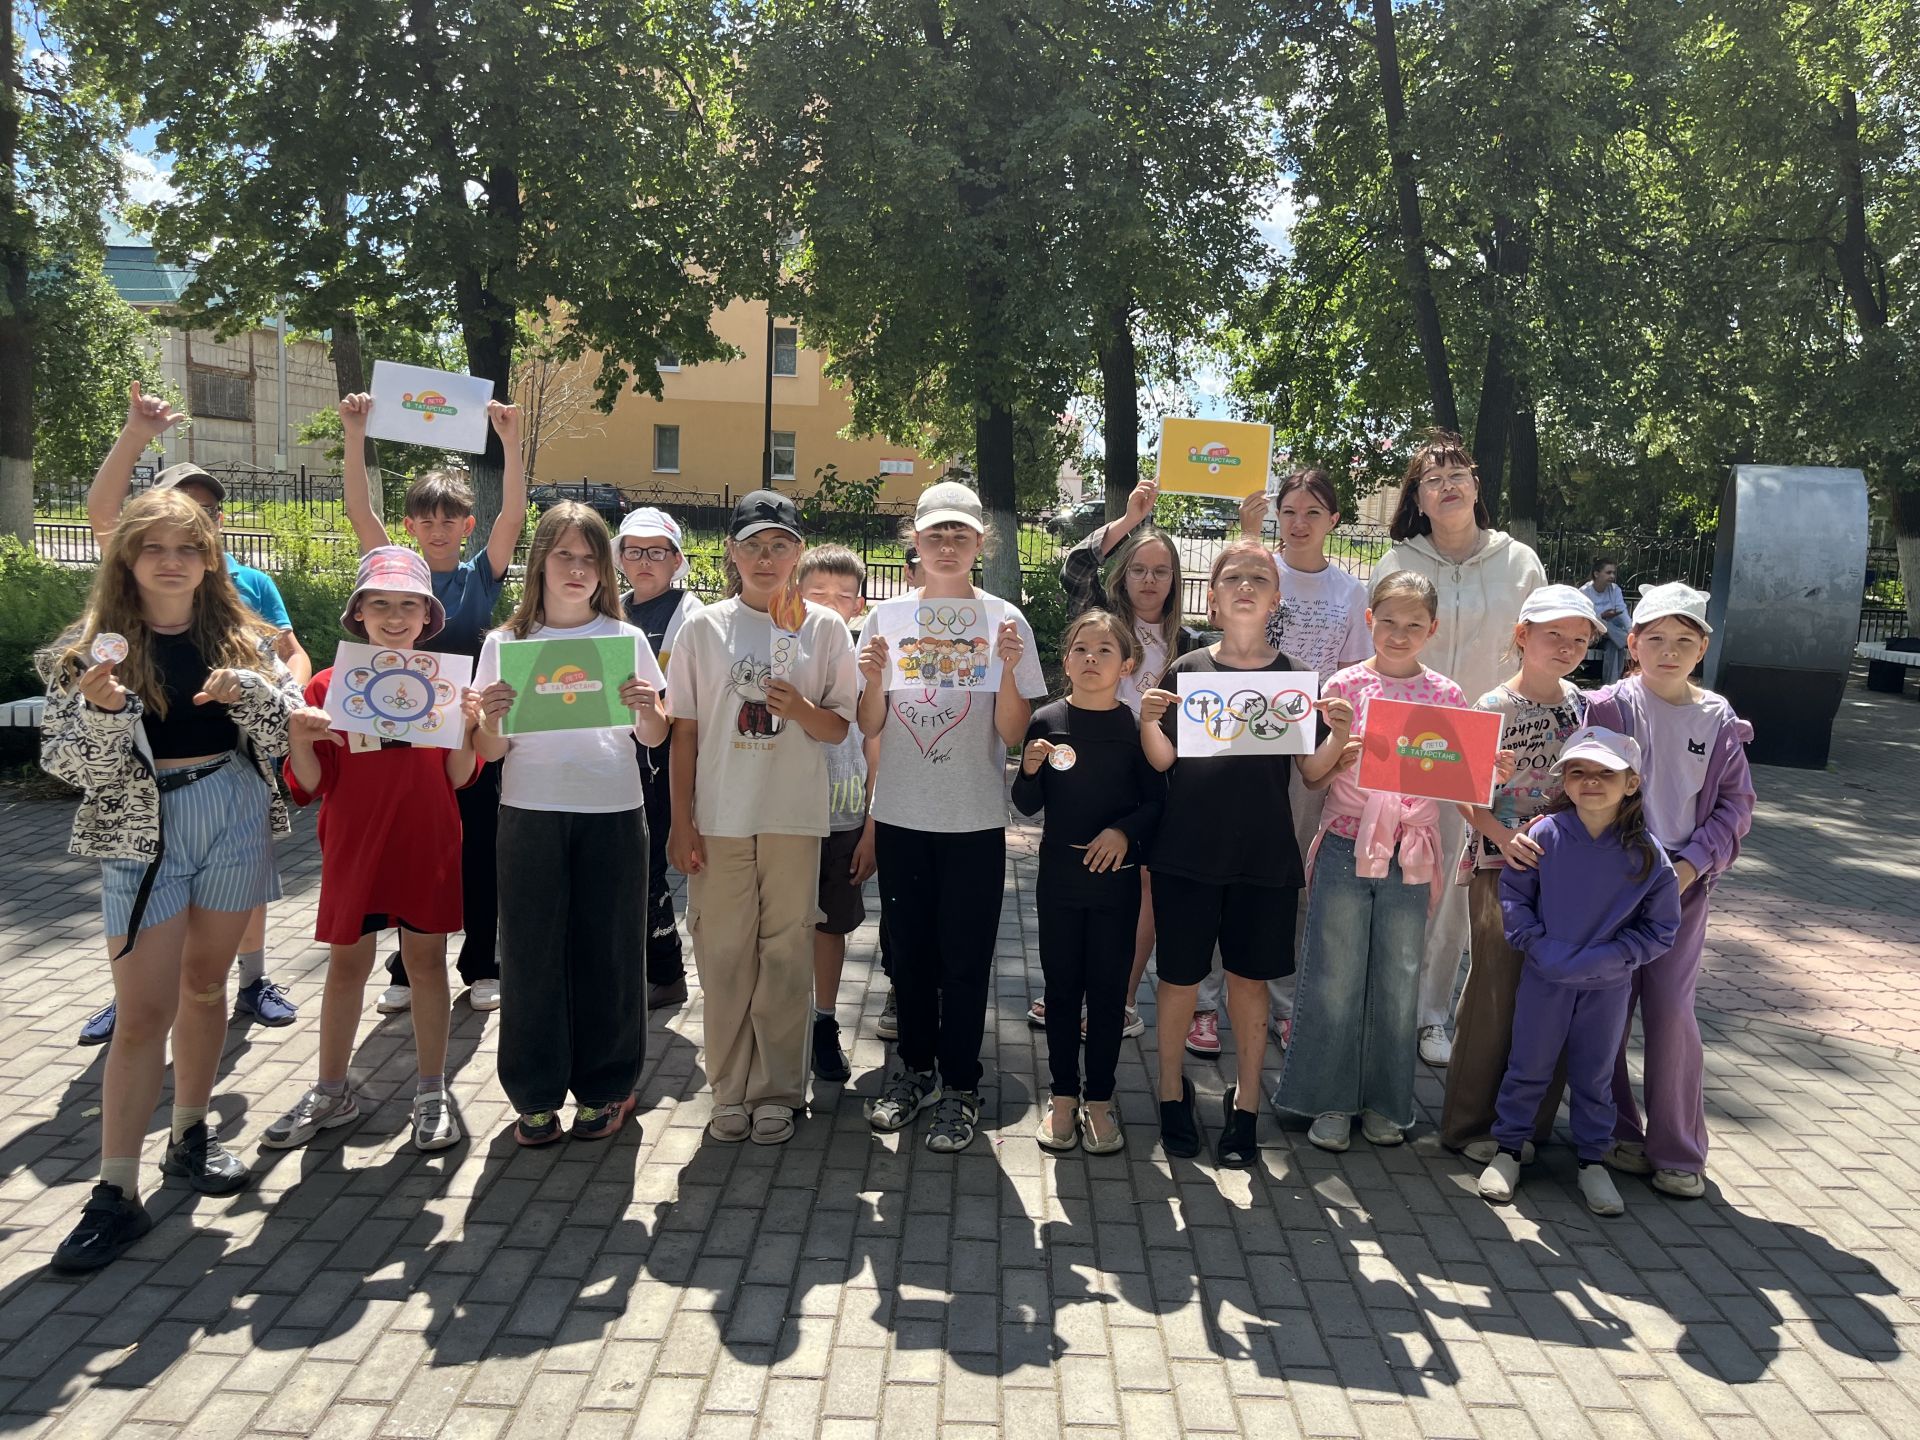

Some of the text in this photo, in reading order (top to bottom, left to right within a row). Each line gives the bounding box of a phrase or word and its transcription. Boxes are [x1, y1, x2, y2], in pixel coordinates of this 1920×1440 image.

[1200, 455, 1238, 465] ТАТАРСТАНЕ
[564, 673, 585, 683] ЛЕТО
[551, 682, 596, 692] ТАТАРСТАНЕ
[1425, 741, 1444, 749] ЛЕТО
[1411, 748, 1456, 761] ТАТАРСТАНЕ
[1514, 753, 1559, 771] VOG
